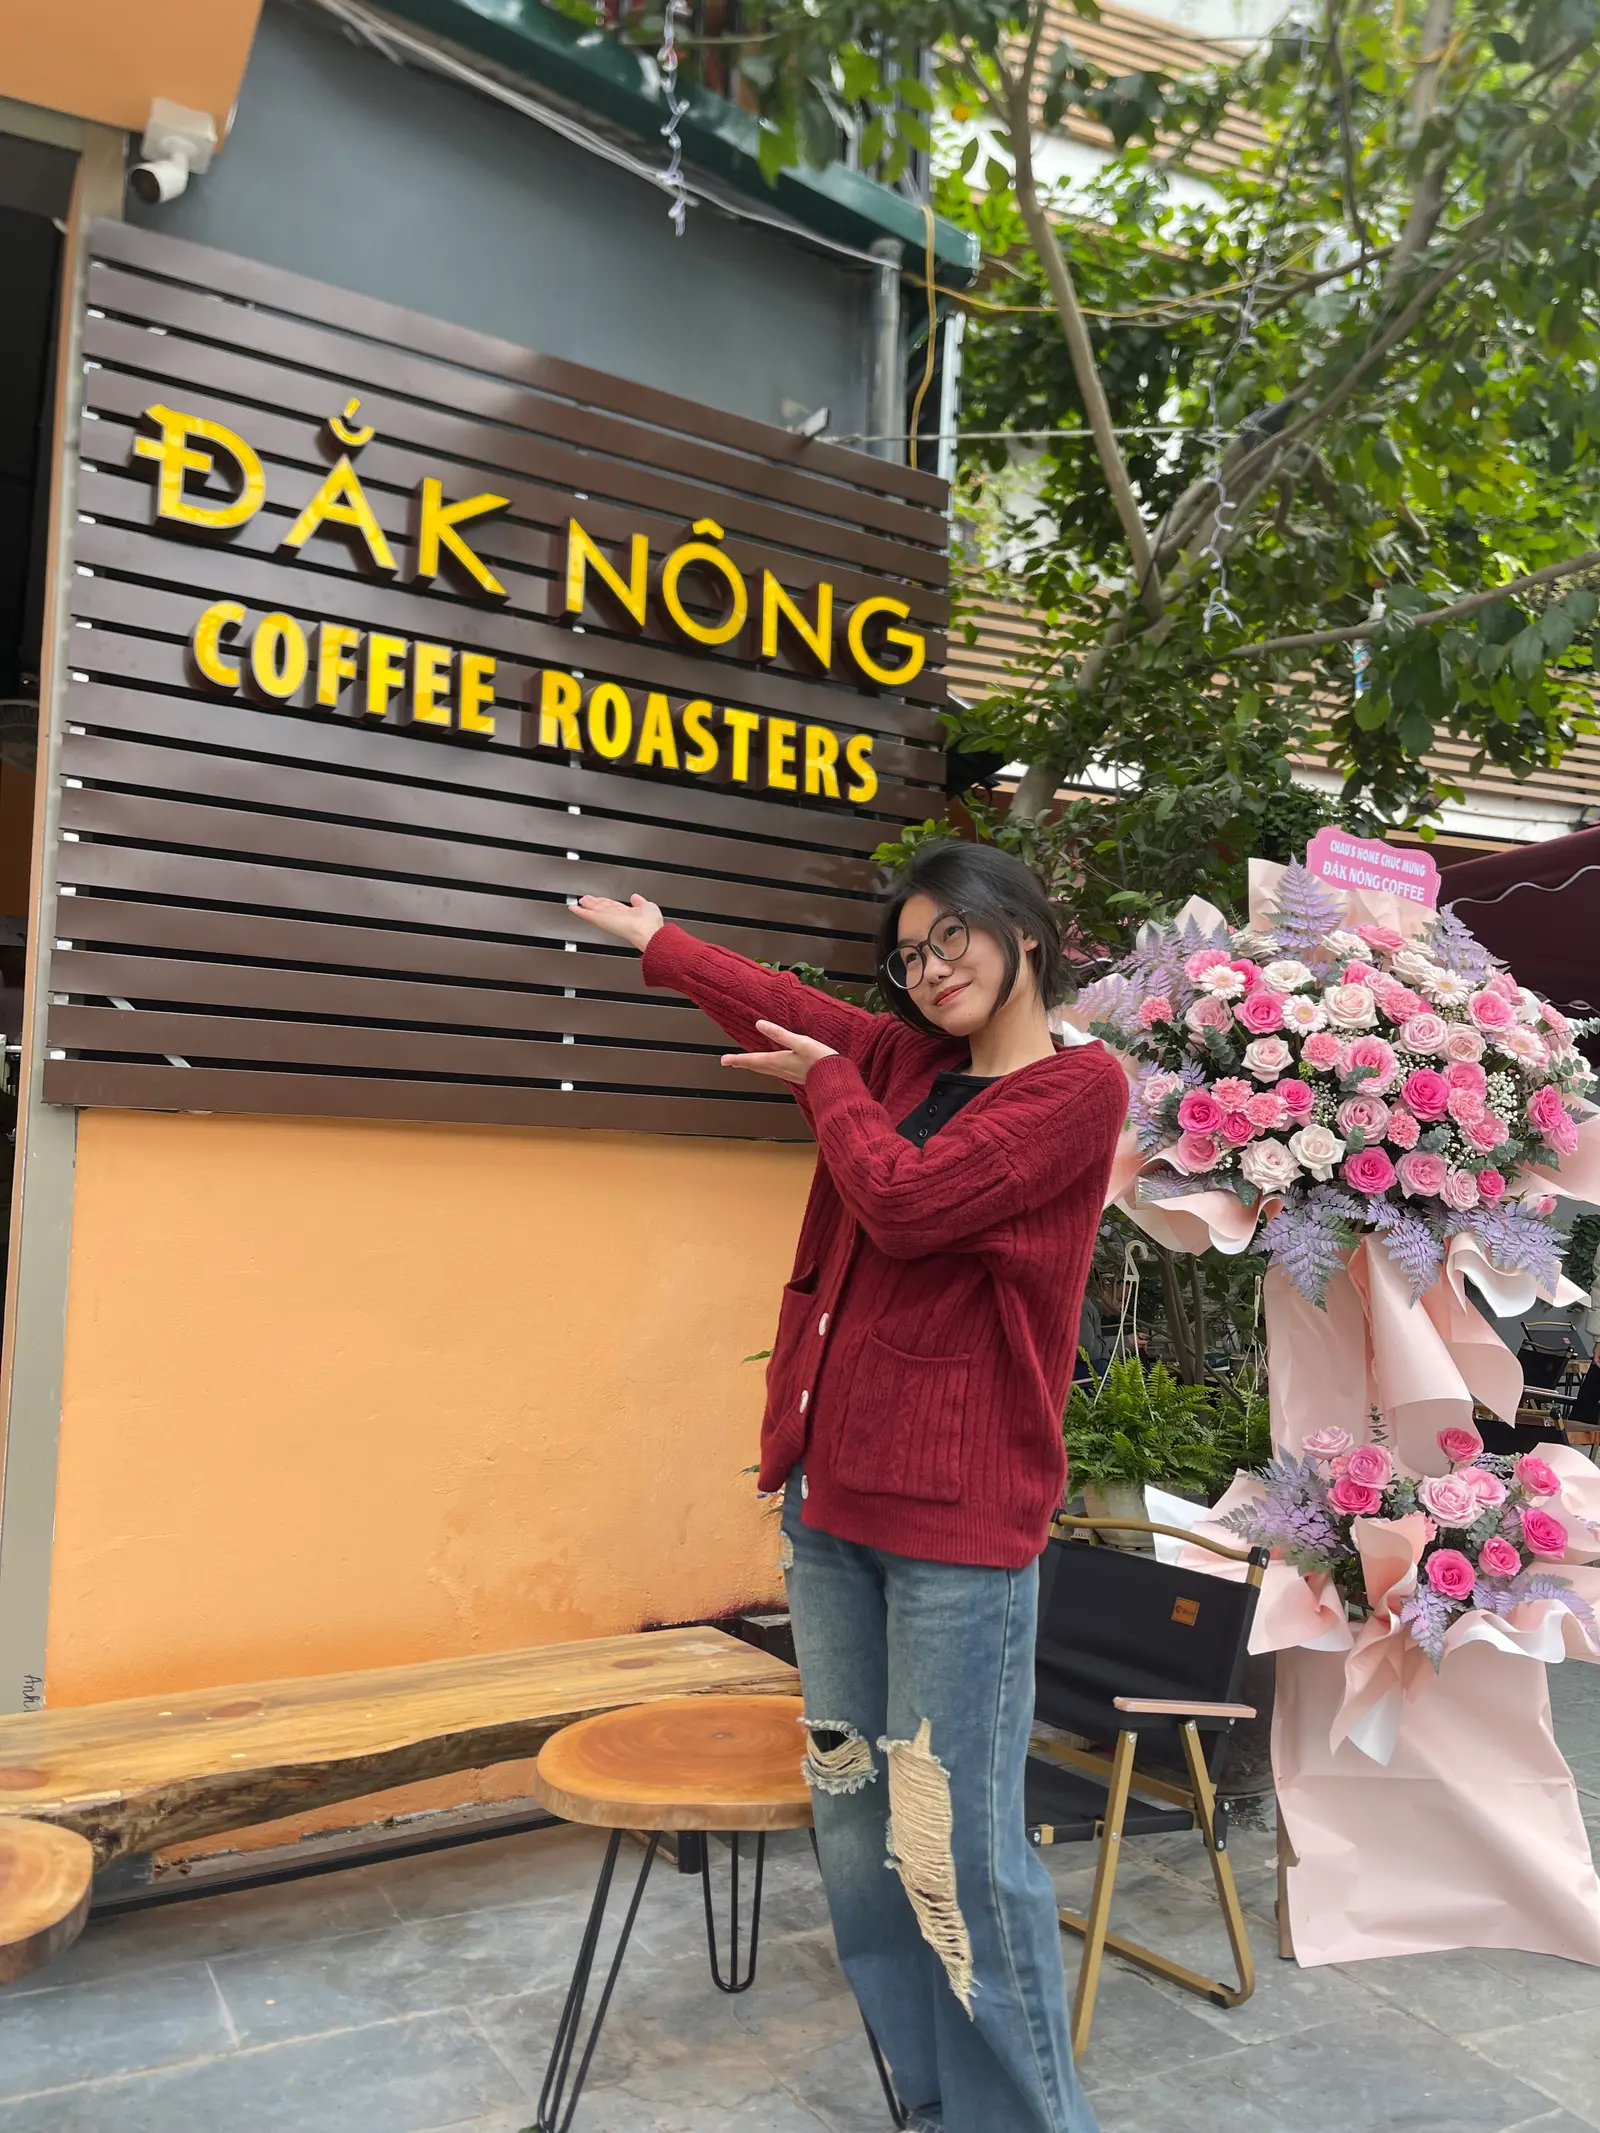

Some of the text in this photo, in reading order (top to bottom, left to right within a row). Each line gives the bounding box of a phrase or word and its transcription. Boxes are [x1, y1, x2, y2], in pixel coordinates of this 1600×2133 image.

[133, 398, 927, 686] ĐẮK NÔNG
[193, 601, 879, 804] COFFEE ROASTERS
[1356, 847, 1380, 865] HOME
[1381, 876, 1425, 902] COFFEE
